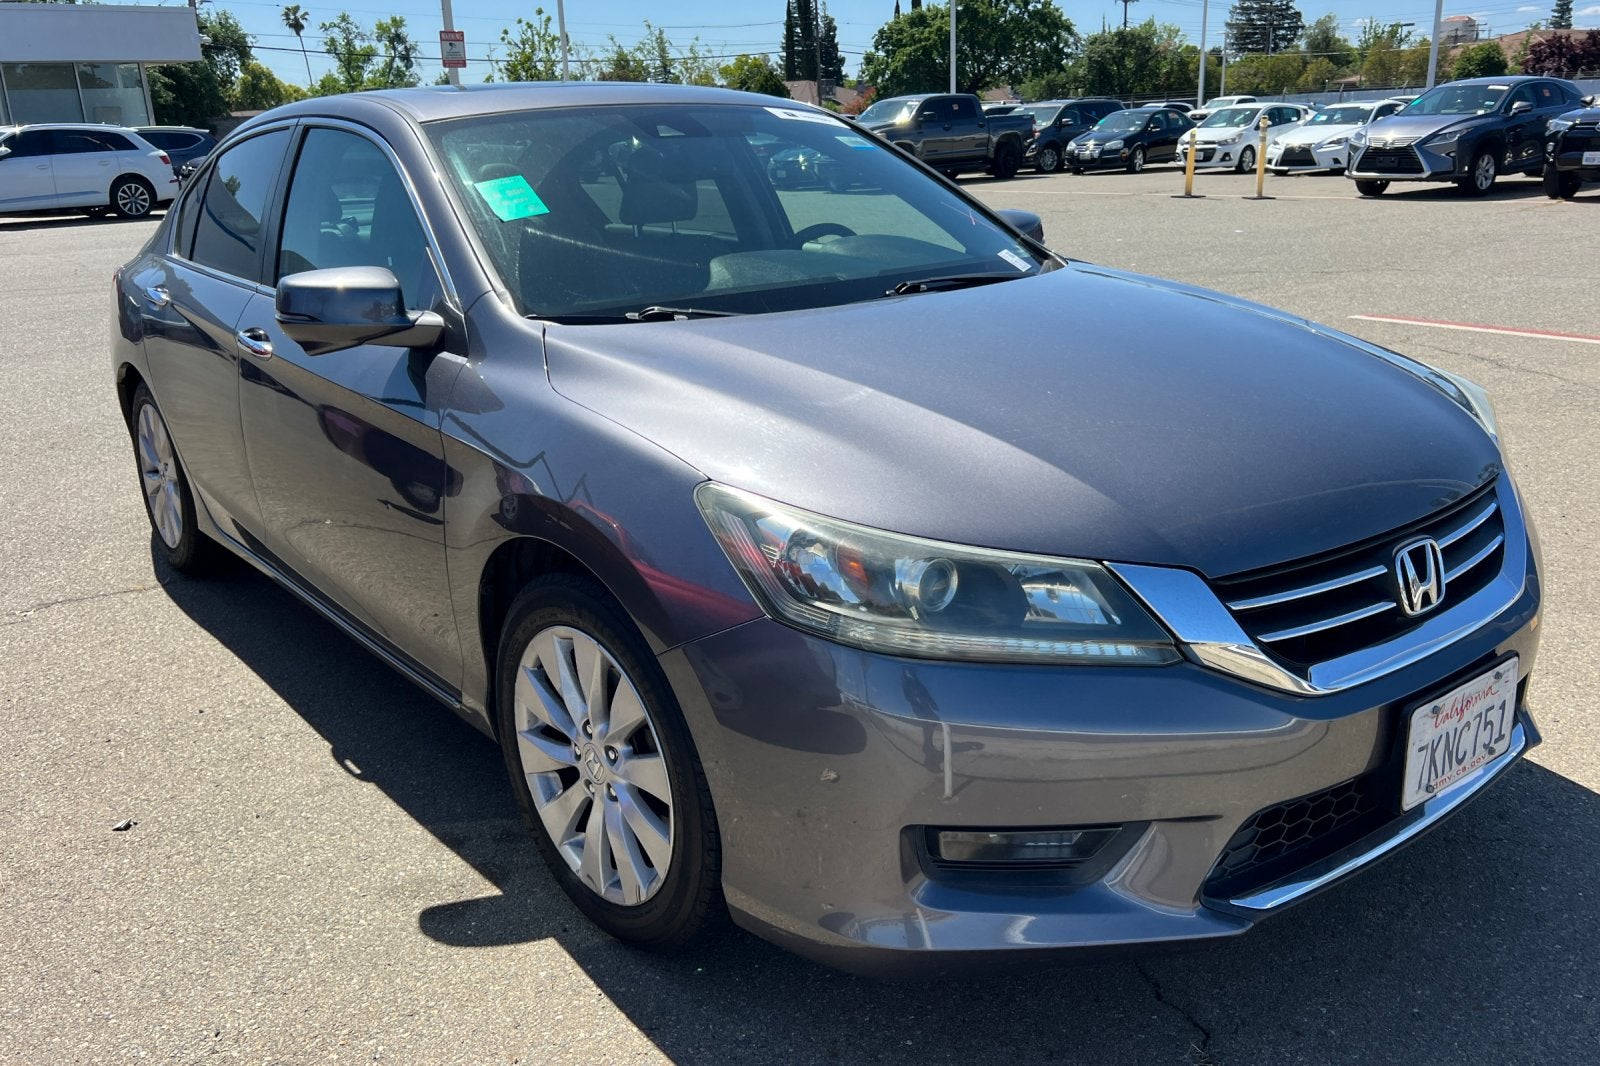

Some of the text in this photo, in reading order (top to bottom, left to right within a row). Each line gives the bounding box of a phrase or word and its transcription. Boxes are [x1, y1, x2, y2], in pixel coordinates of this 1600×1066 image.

[441, 32, 463, 41] WARNING
[1433, 682, 1500, 729] California
[1416, 699, 1507, 793] 7KNC751
[1433, 752, 1487, 790] dmv.ca.gov
